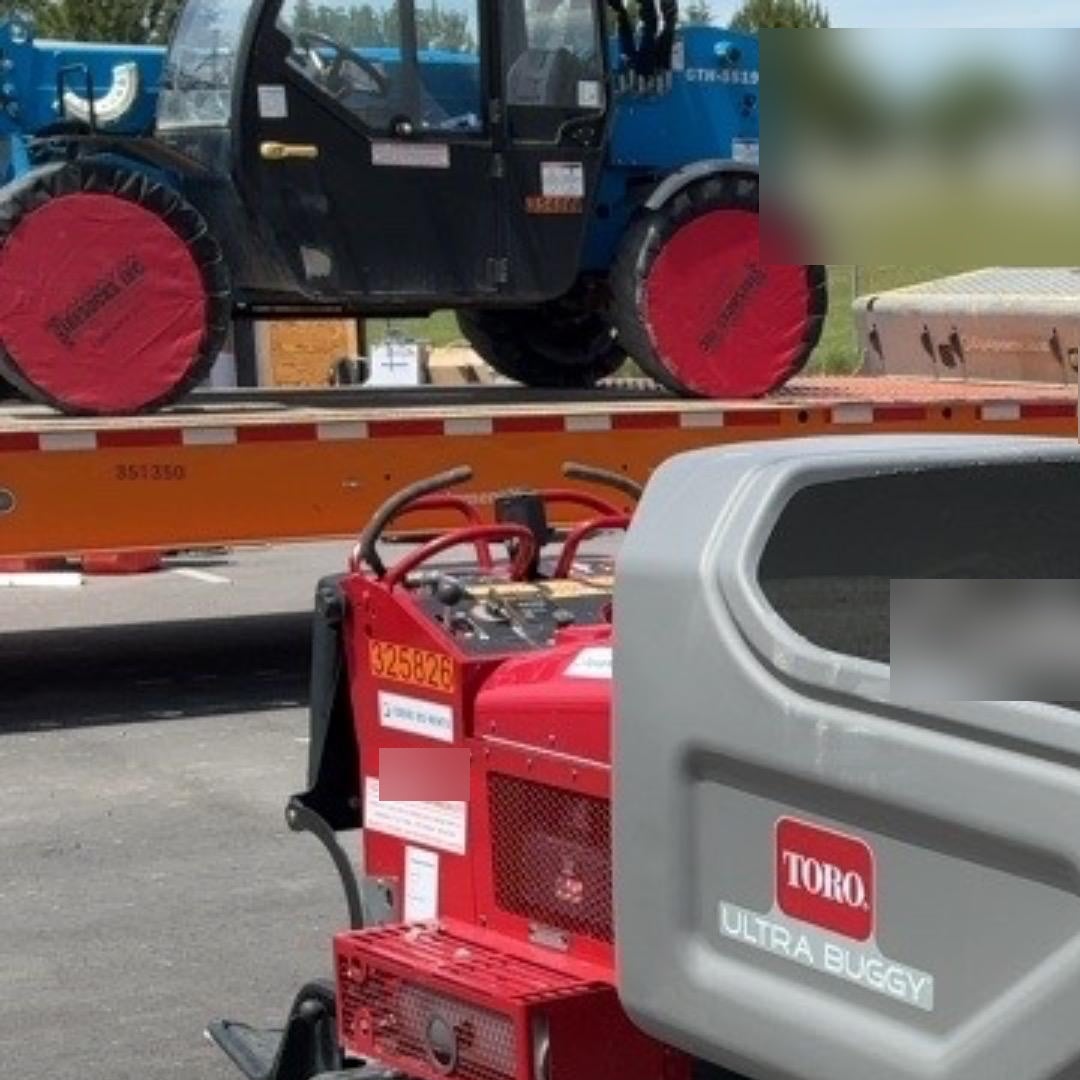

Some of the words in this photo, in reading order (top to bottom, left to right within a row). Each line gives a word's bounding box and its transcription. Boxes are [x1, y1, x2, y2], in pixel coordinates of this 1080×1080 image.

[373, 642, 451, 687] 325826
[783, 850, 867, 908] TORO
[722, 906, 813, 965] ULTRA
[823, 944, 926, 1004] BUGGY
